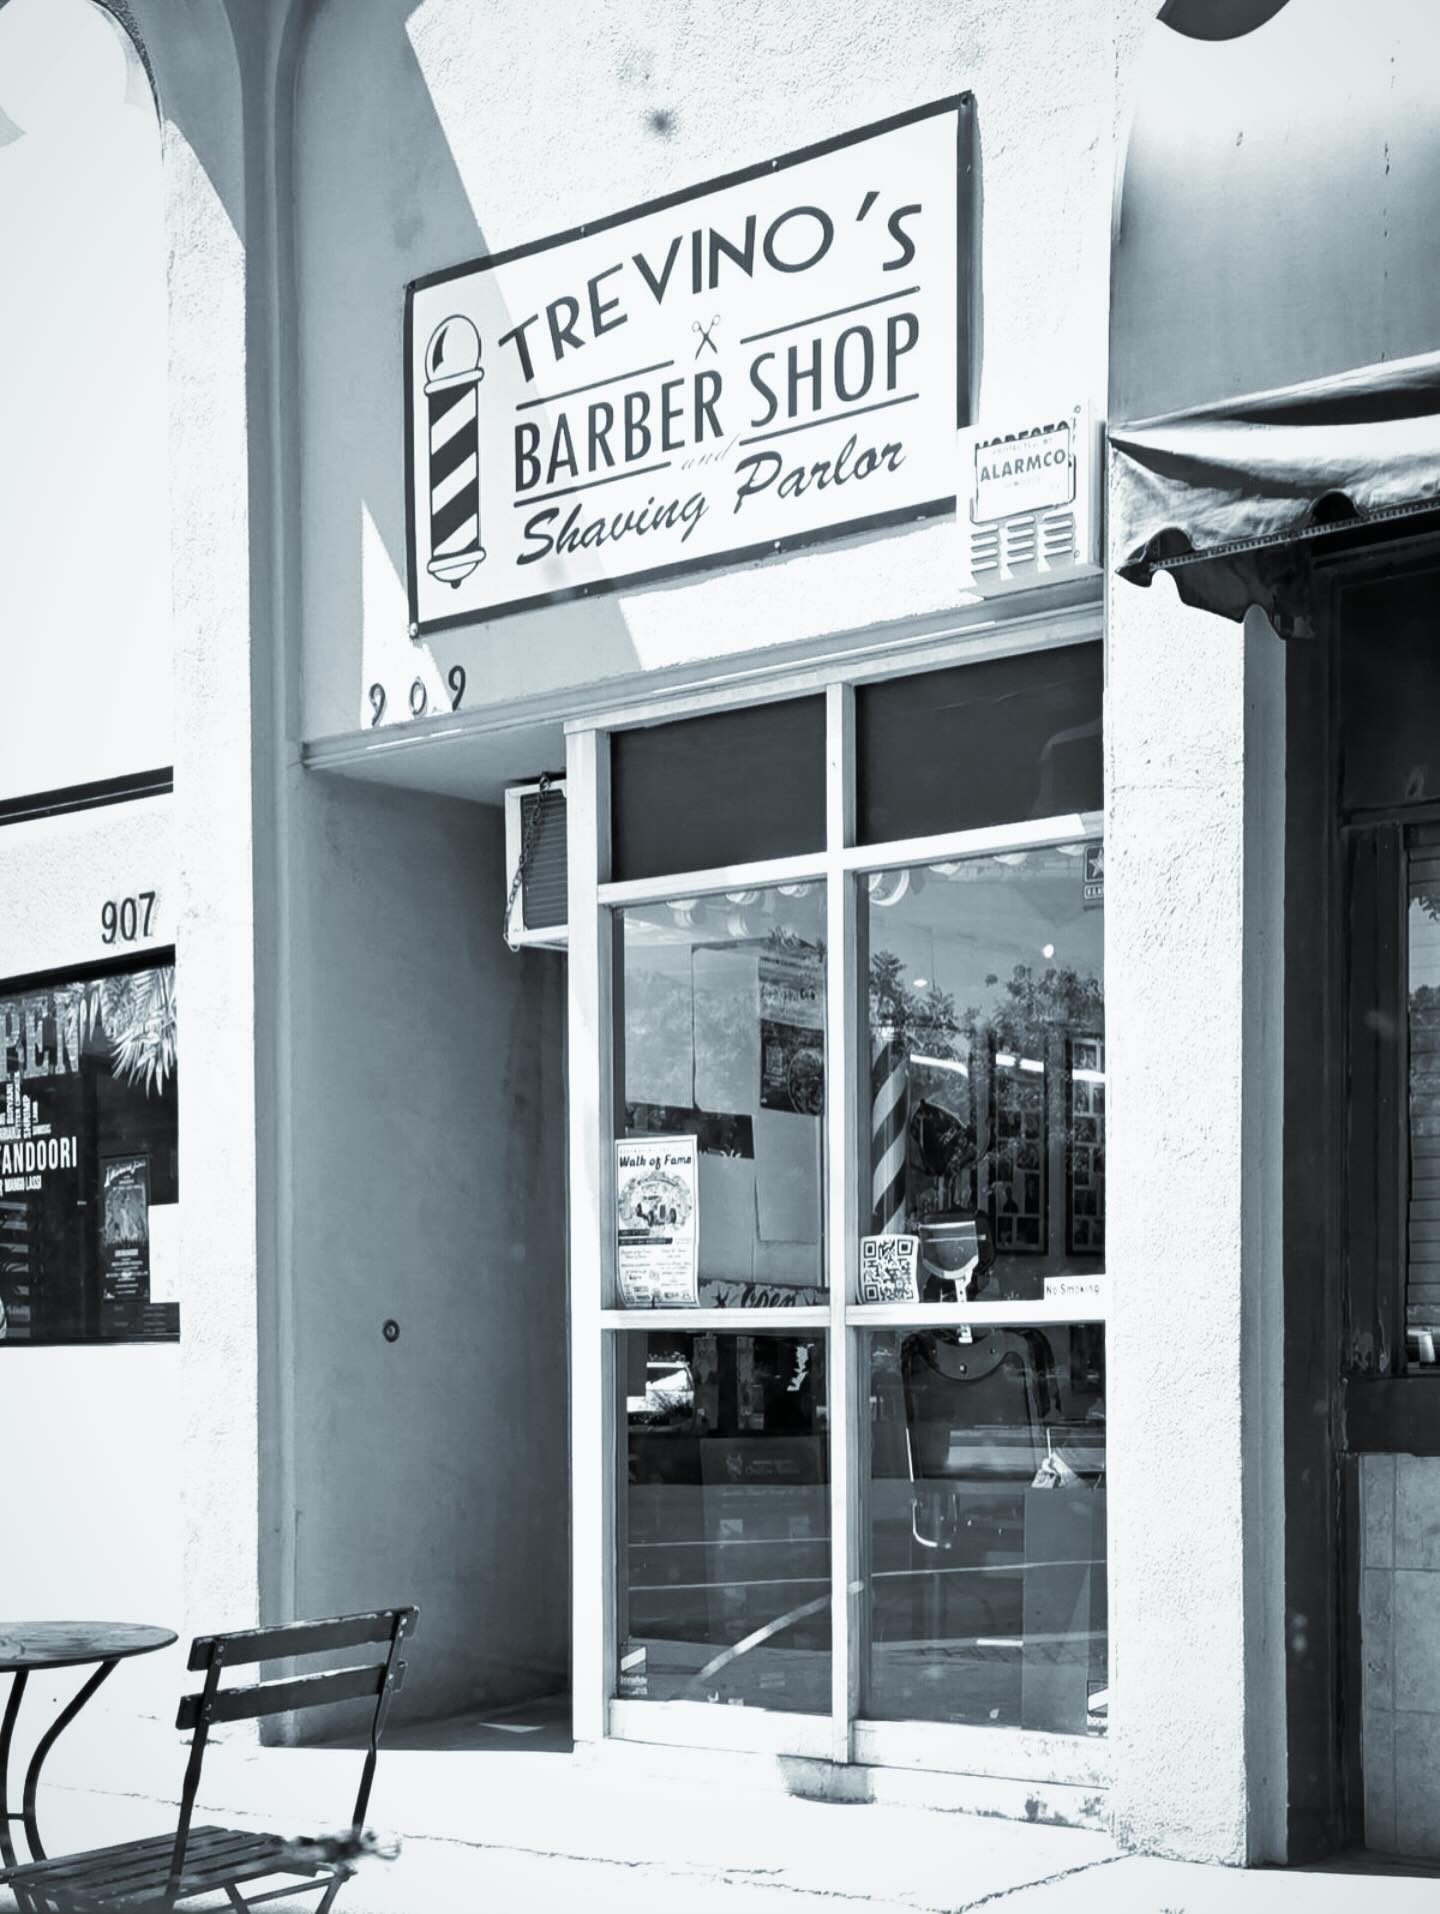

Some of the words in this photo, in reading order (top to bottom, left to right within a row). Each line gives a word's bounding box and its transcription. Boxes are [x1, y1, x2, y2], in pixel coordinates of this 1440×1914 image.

[498, 190, 923, 383] TREVINO'S
[513, 368, 724, 493] BARBER
[749, 311, 920, 428] SHOP
[681, 432, 741, 471] and
[979, 448, 1067, 483] ALARMCO
[516, 491, 709, 566] Shaving
[733, 433, 905, 515] Parlor
[101, 891, 156, 945] 907
[0, 1136, 77, 1175] ANDOORI
[619, 1155, 646, 1168] Walk
[649, 1156, 661, 1170] of
[1046, 1284, 1058, 1296] No
